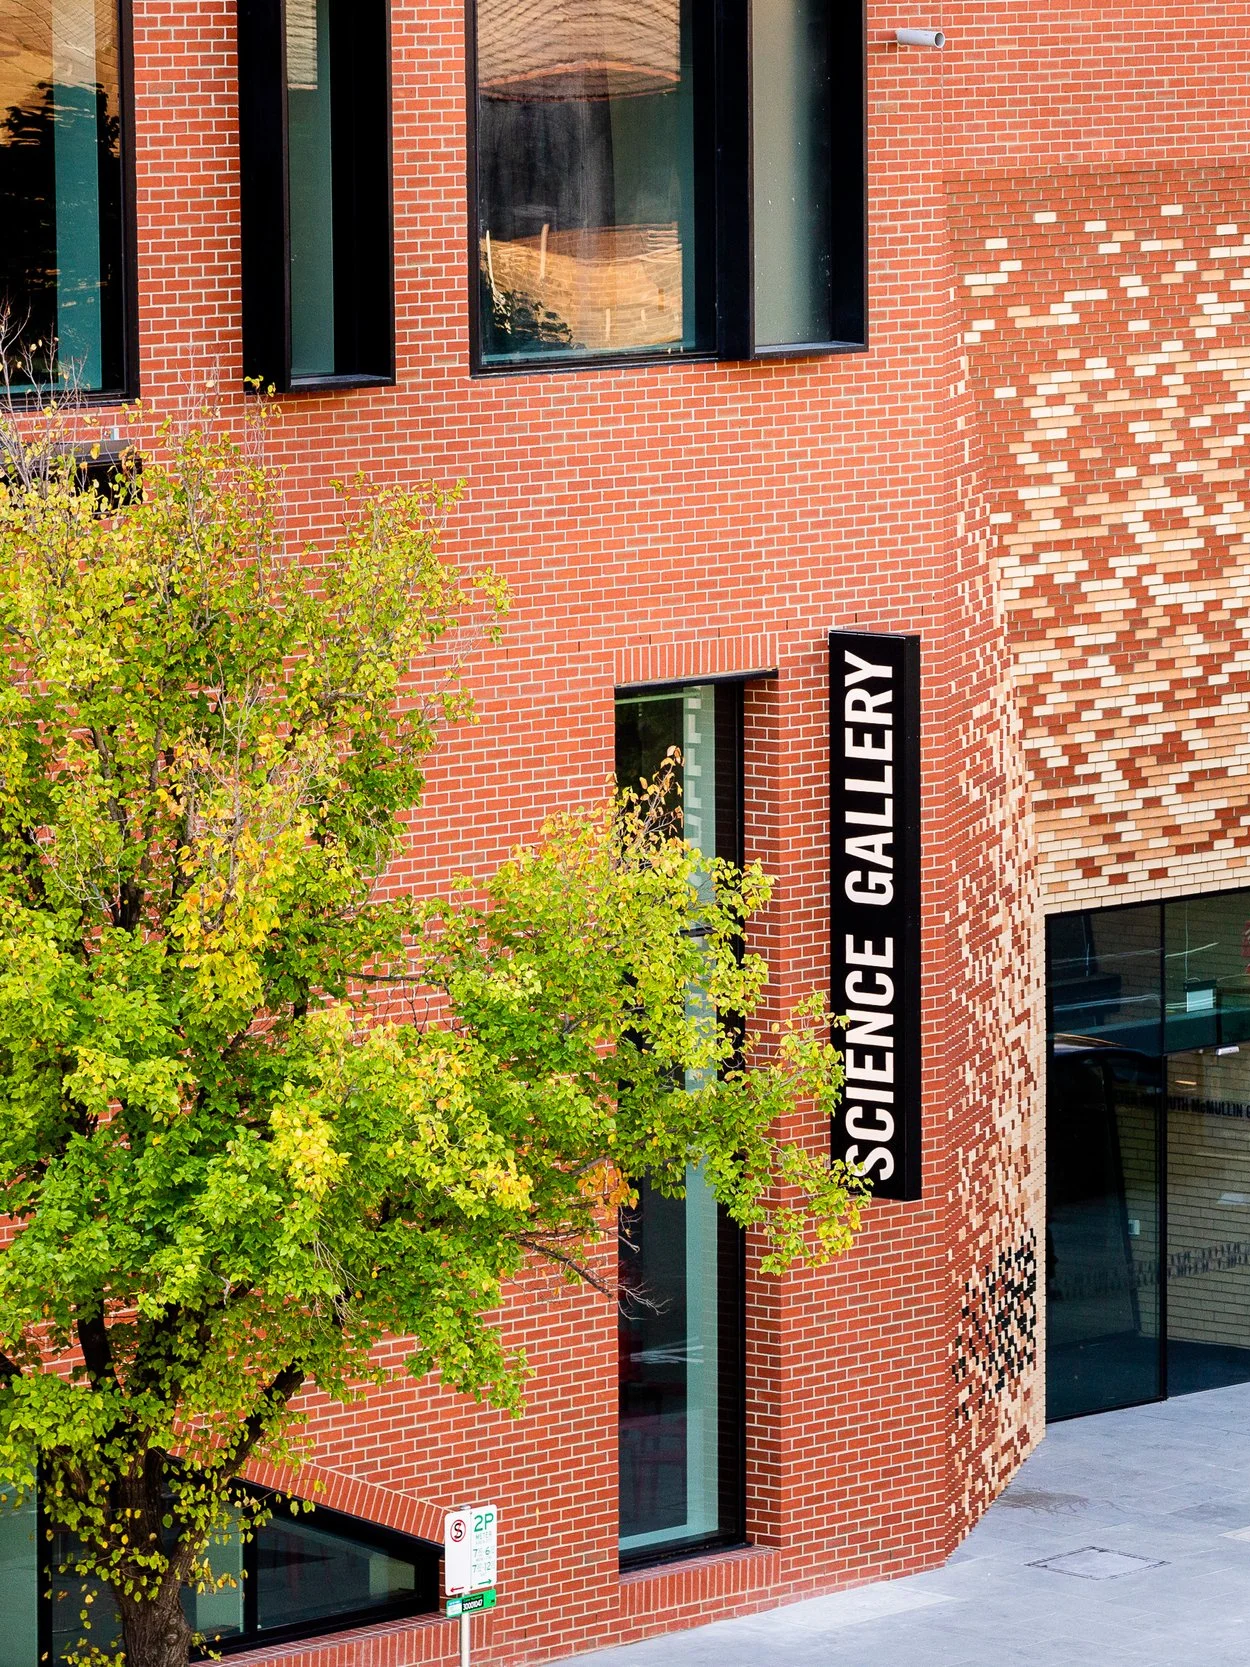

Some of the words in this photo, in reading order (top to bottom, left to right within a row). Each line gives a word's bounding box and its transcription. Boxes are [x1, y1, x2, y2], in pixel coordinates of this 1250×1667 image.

[844, 650, 893, 906] GALLERY
[845, 933, 895, 1181] SCIENCE
[1166, 1095, 1189, 1112] UTH
[474, 1513, 494, 1532] 2P
